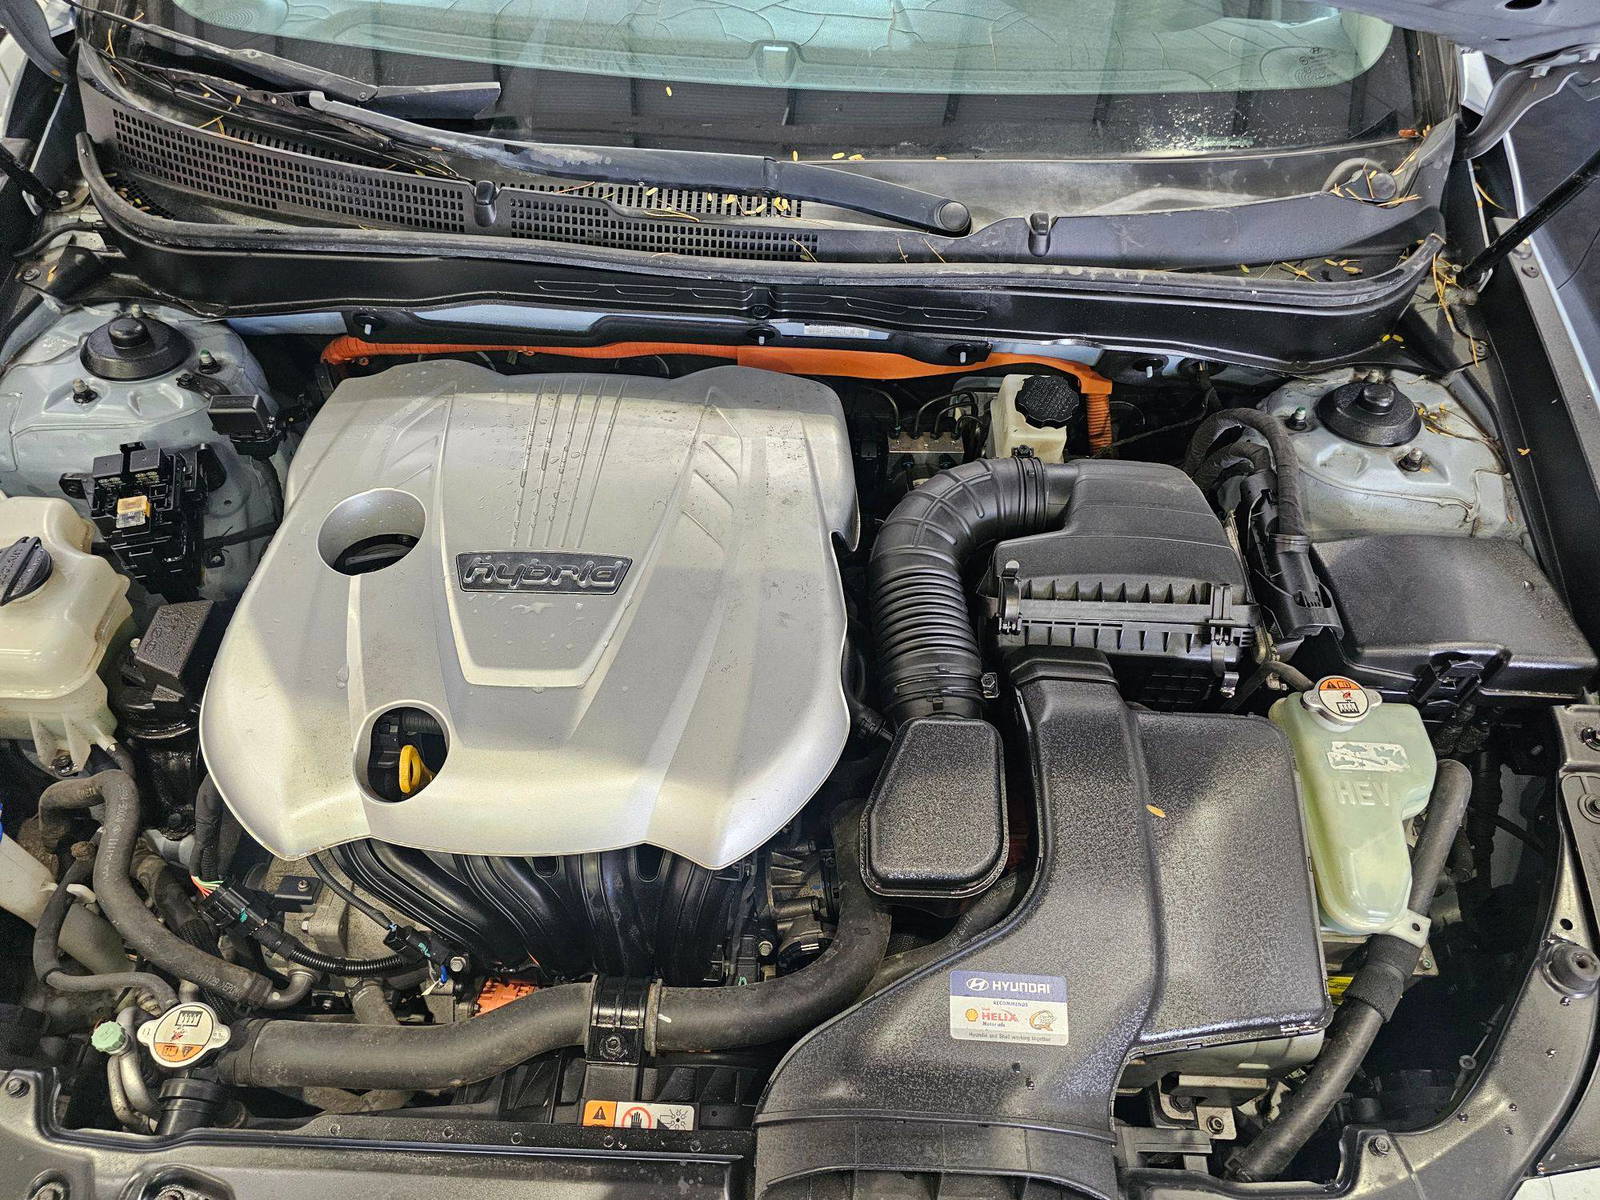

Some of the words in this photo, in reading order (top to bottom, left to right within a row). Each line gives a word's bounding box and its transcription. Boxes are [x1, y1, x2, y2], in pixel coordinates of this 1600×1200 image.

[463, 557, 623, 589] hybrid
[1332, 780, 1391, 807] HEV
[992, 980, 1050, 994] HYUNDAI
[982, 1010, 1017, 1022] HELIX
